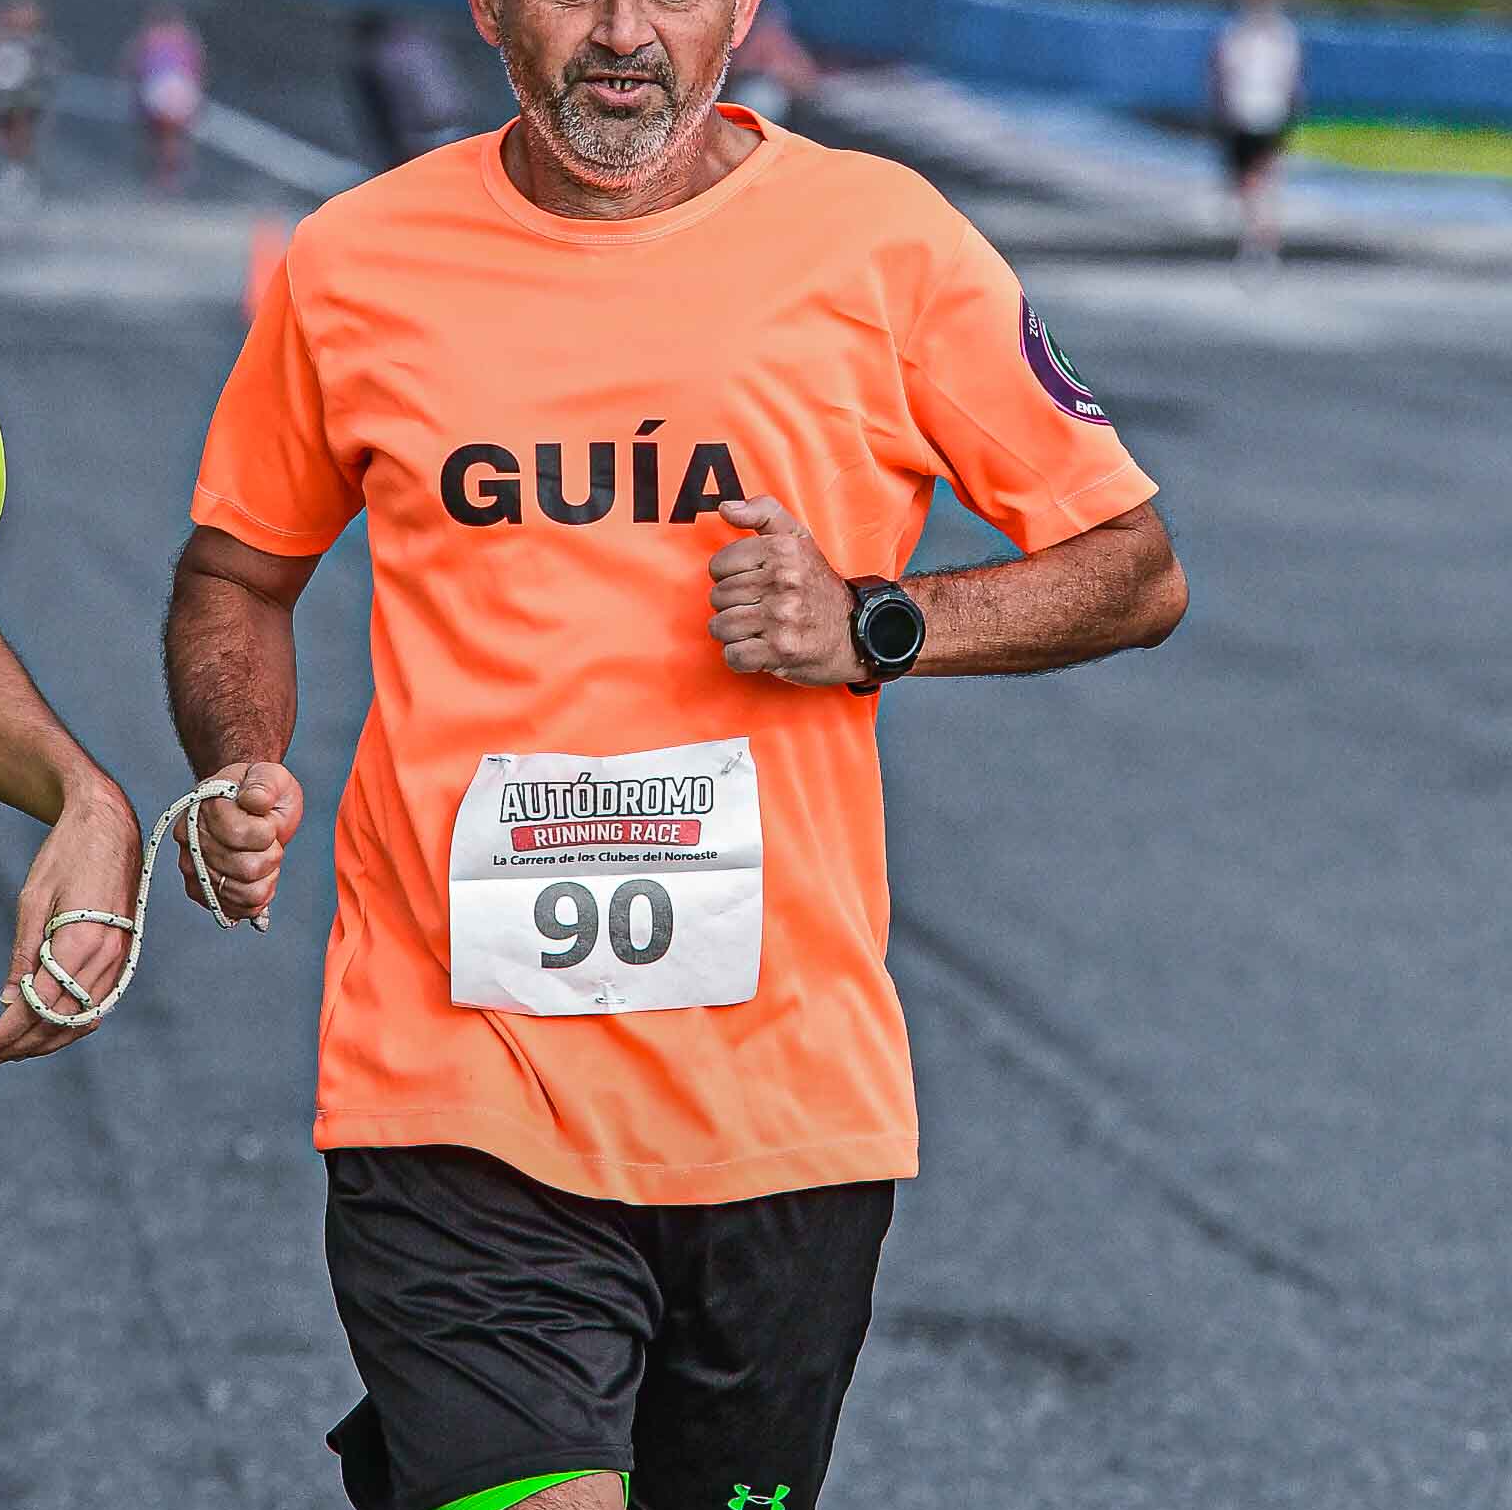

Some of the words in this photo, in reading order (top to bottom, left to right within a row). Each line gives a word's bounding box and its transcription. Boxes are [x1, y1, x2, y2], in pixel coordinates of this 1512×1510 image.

[440, 419, 748, 527] GUÍA
[499, 772, 714, 823] AUTÓDROMO
[493, 855, 507, 866] La
[510, 855, 556, 866] Carrera
[559, 853, 575, 864] de
[578, 852, 596, 862] los
[599, 852, 639, 863] Clubes
[642, 851, 662, 862] del
[664, 850, 718, 861] Noroeste
[533, 823, 623, 847] RUNNING
[630, 823, 681, 843] RACE
[534, 879, 674, 969] 90
